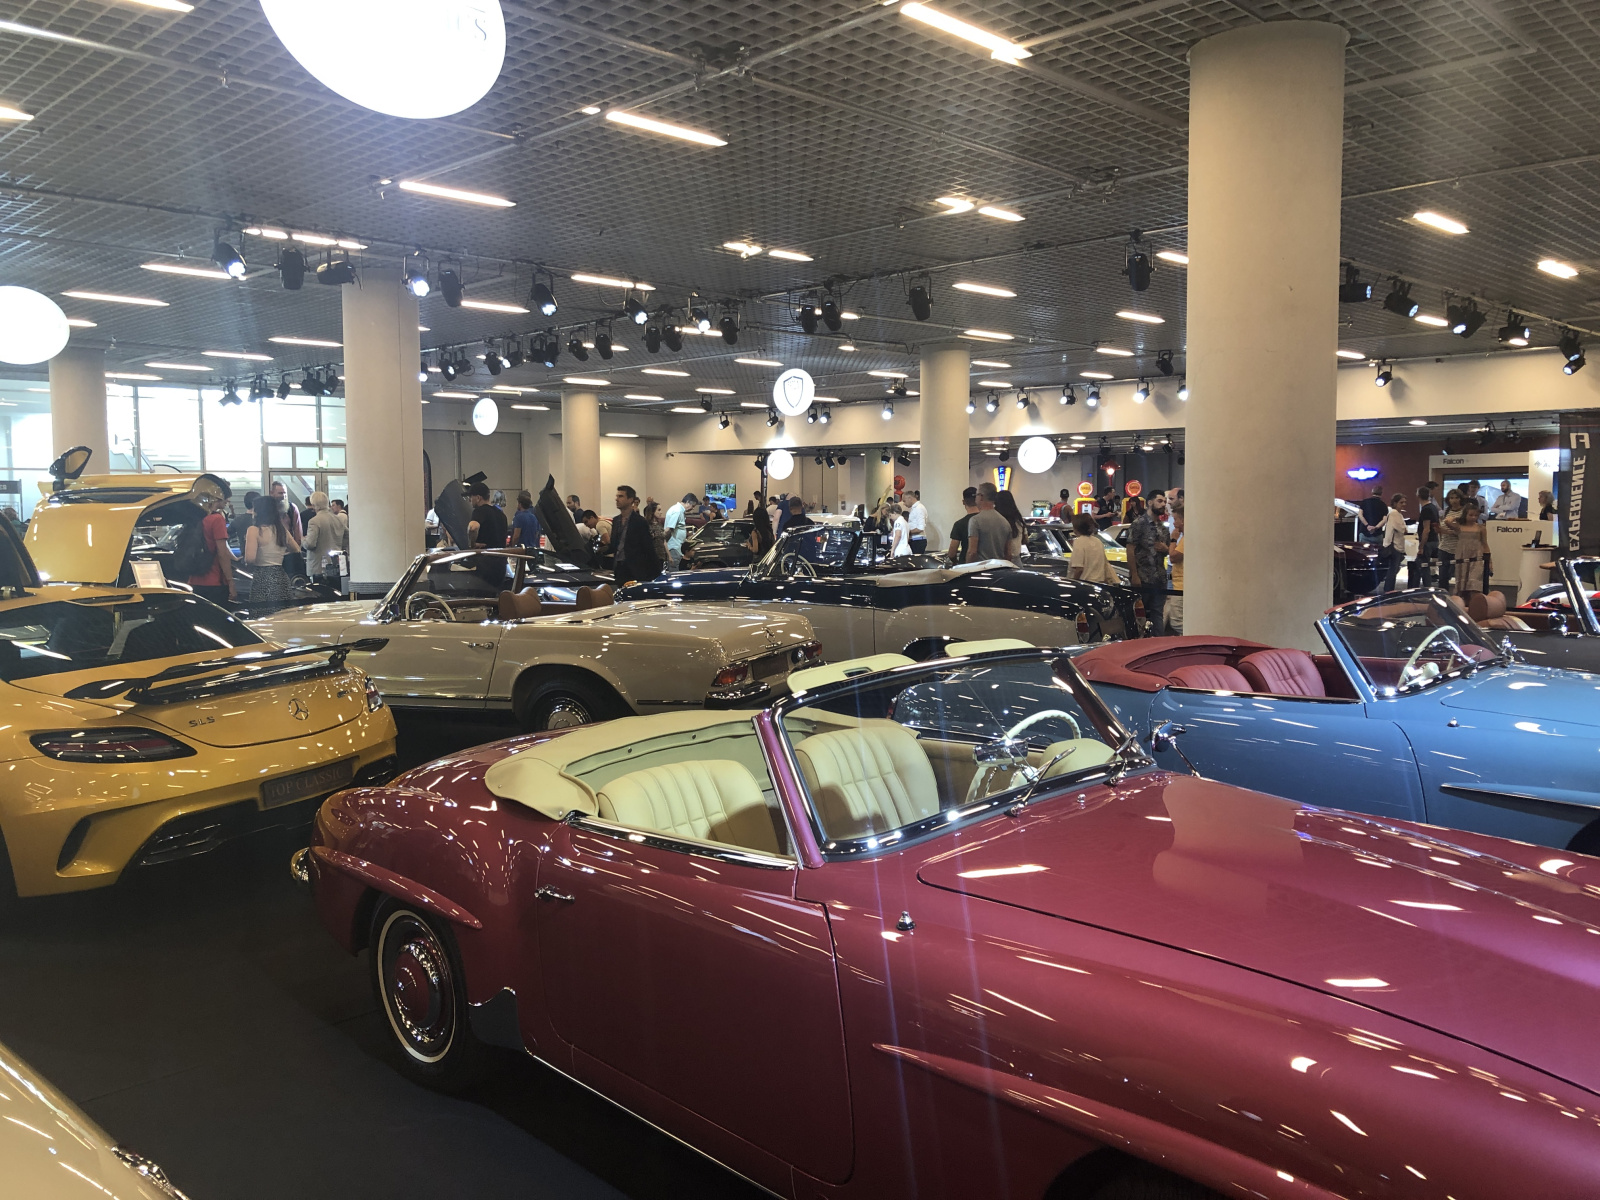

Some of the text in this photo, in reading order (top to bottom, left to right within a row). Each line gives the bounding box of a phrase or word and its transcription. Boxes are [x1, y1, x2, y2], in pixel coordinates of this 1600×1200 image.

[1569, 455, 1586, 551] EXPERIENCE
[189, 716, 215, 727] SLS
[270, 767, 344, 798] TOP CLASSIC
